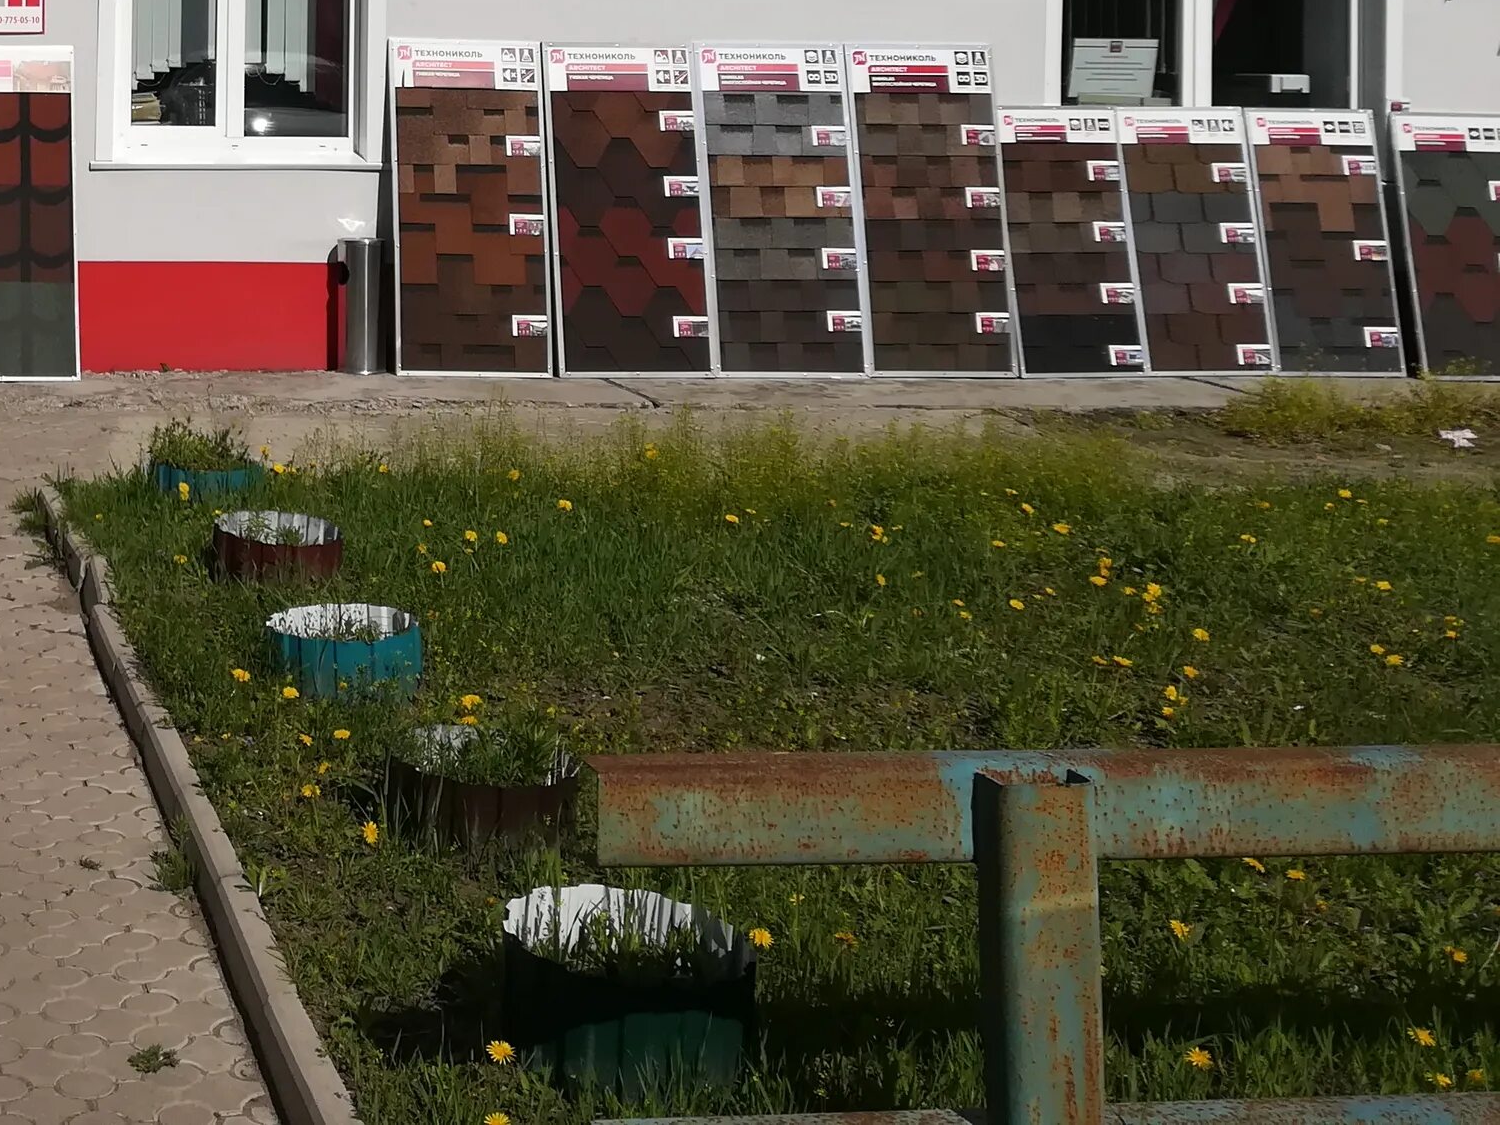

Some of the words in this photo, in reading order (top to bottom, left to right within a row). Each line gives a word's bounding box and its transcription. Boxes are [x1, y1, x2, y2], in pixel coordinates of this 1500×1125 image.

[415, 49, 483, 58] ТЕХНОНИКОЛЬ
[719, 53, 787, 61] ТЕХНОНИКОЛЬ
[869, 54, 937, 62] ТЕХНОНИКОЛЬ
